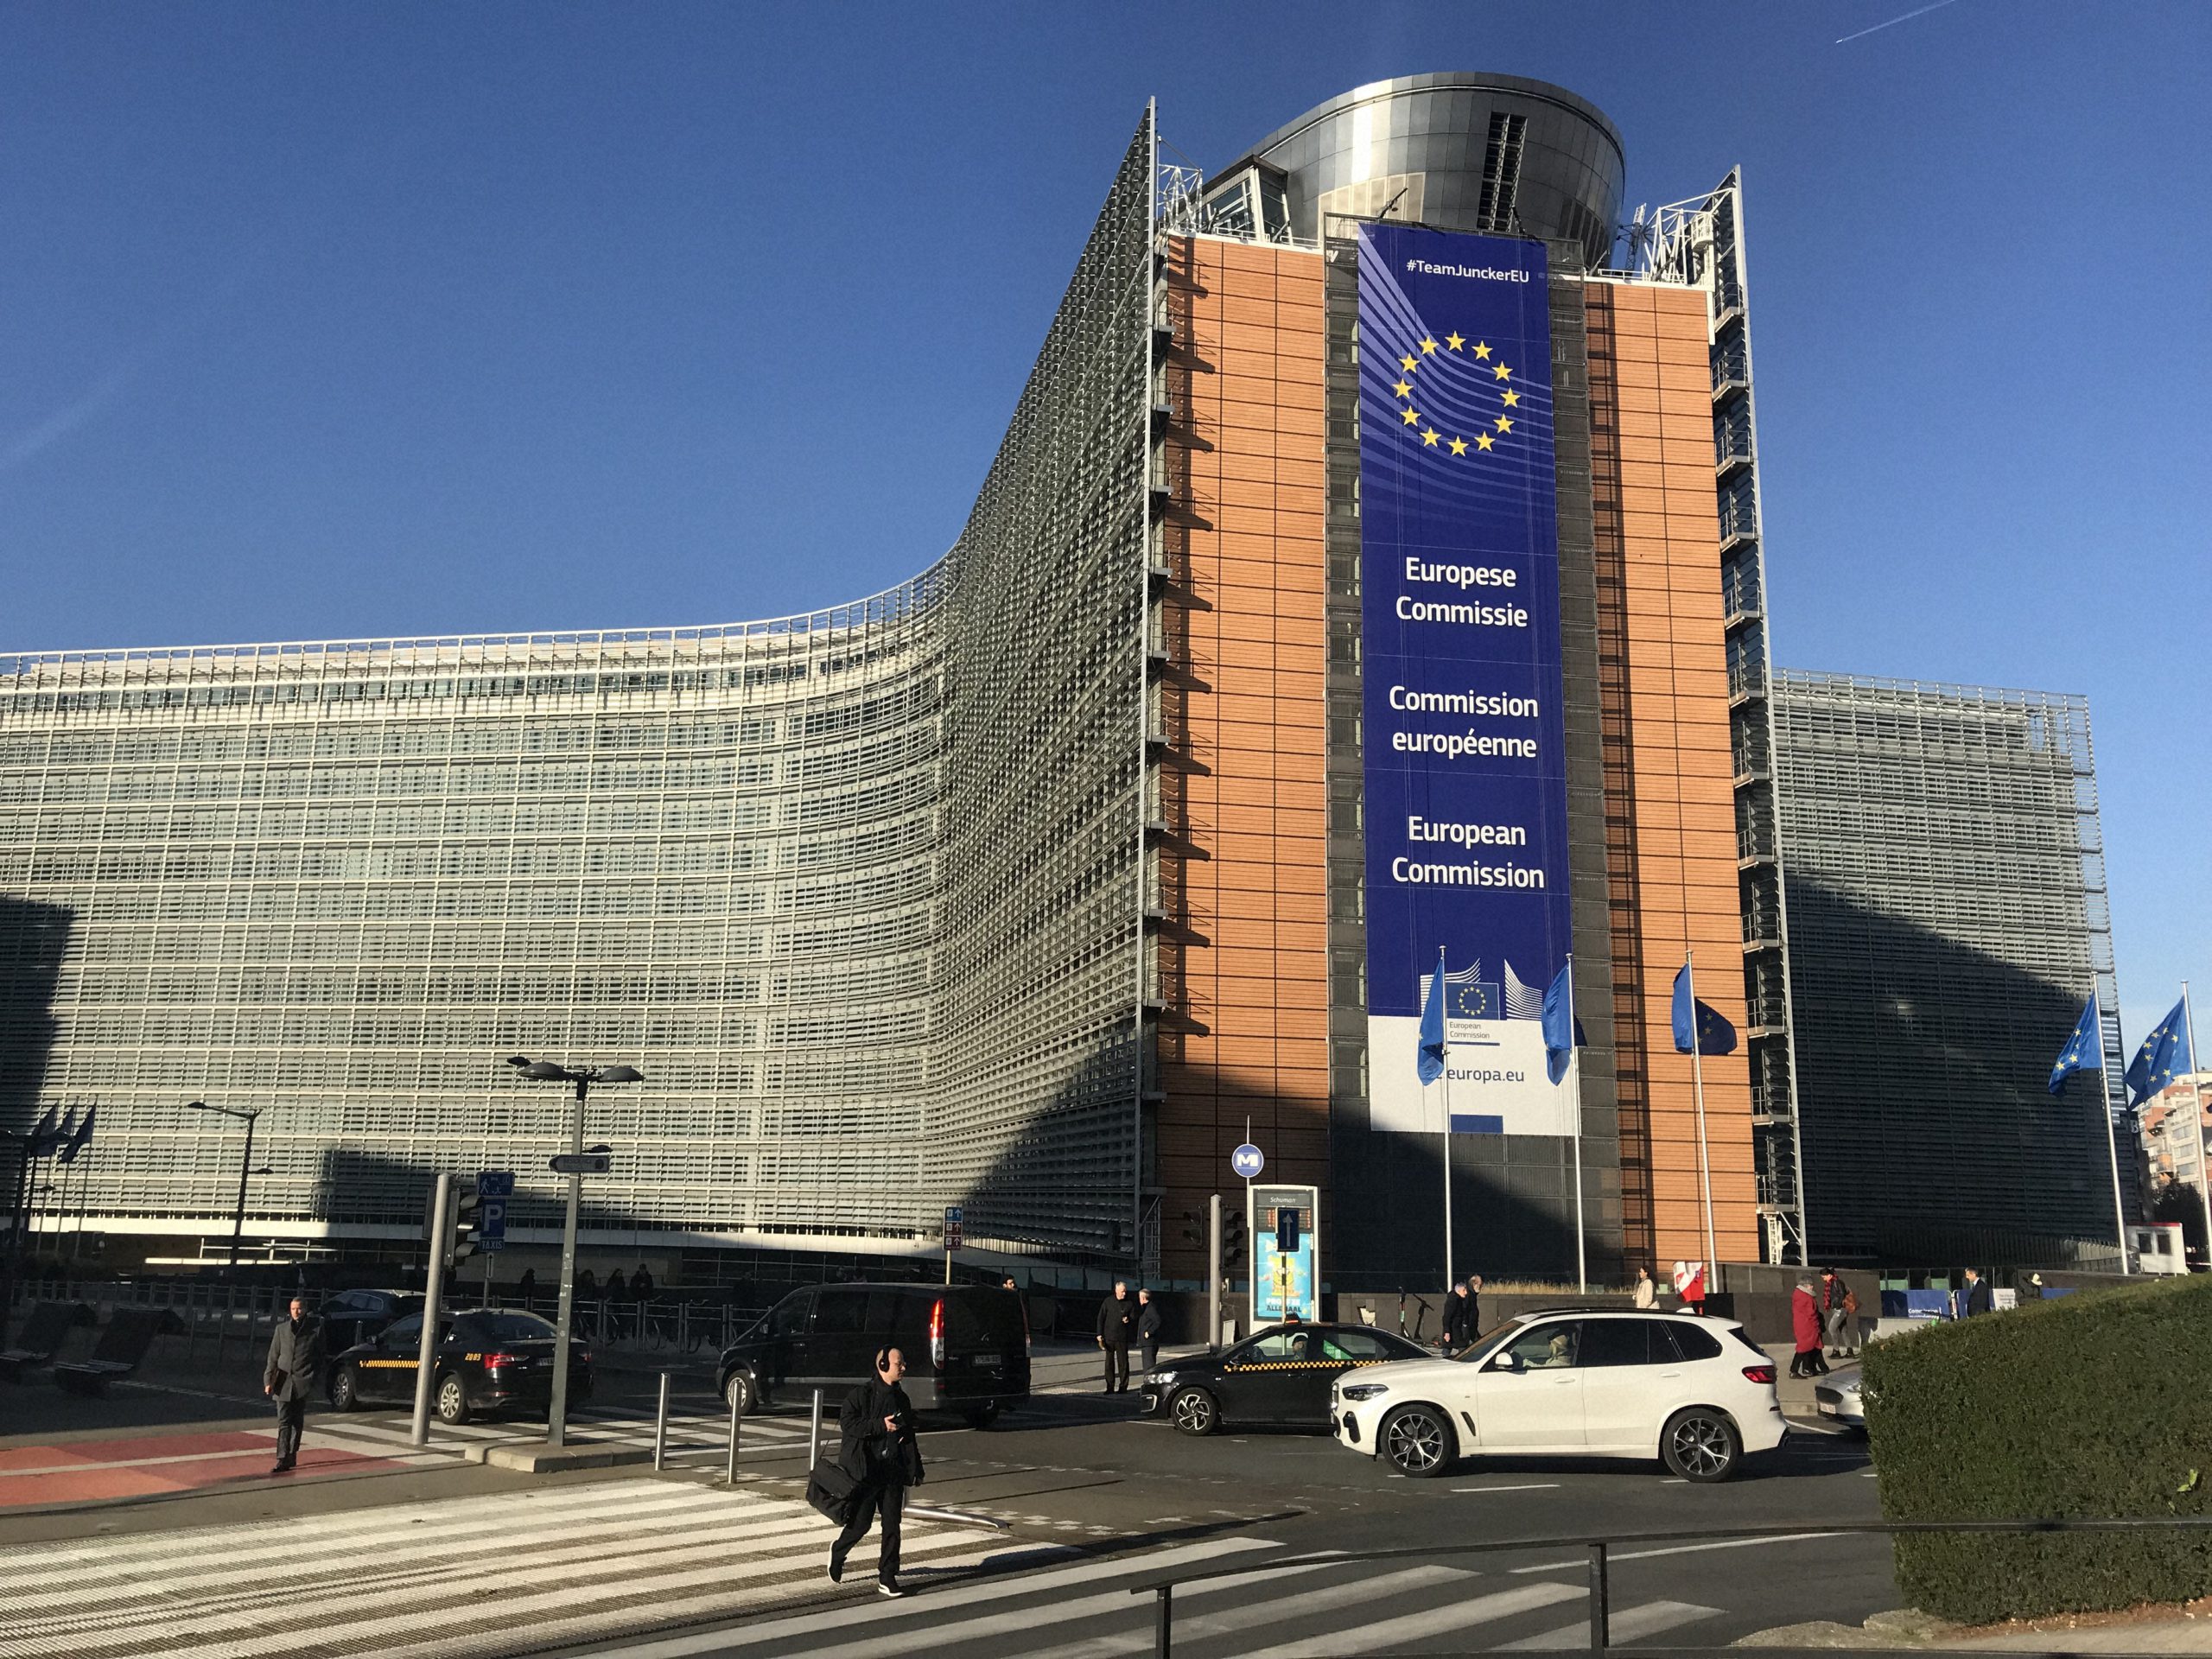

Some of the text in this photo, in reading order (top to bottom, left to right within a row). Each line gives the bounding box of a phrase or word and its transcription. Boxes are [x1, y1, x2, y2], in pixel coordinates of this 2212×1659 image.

[1407, 259, 1529, 283] #TeamJunckerEU
[1406, 556, 1516, 590] Europese
[1395, 596, 1528, 627] Commissie
[1389, 685, 1538, 717] Commission
[1392, 728, 1537, 760] européenne
[1408, 816, 1526, 849] European
[1392, 856, 1544, 888] Commission
[1449, 1021, 1481, 1030] European
[1449, 1030, 1490, 1039] Commission
[1237, 1154, 1259, 1166] M
[484, 1204, 504, 1231] P
[481, 1241, 503, 1249] TAXIS
